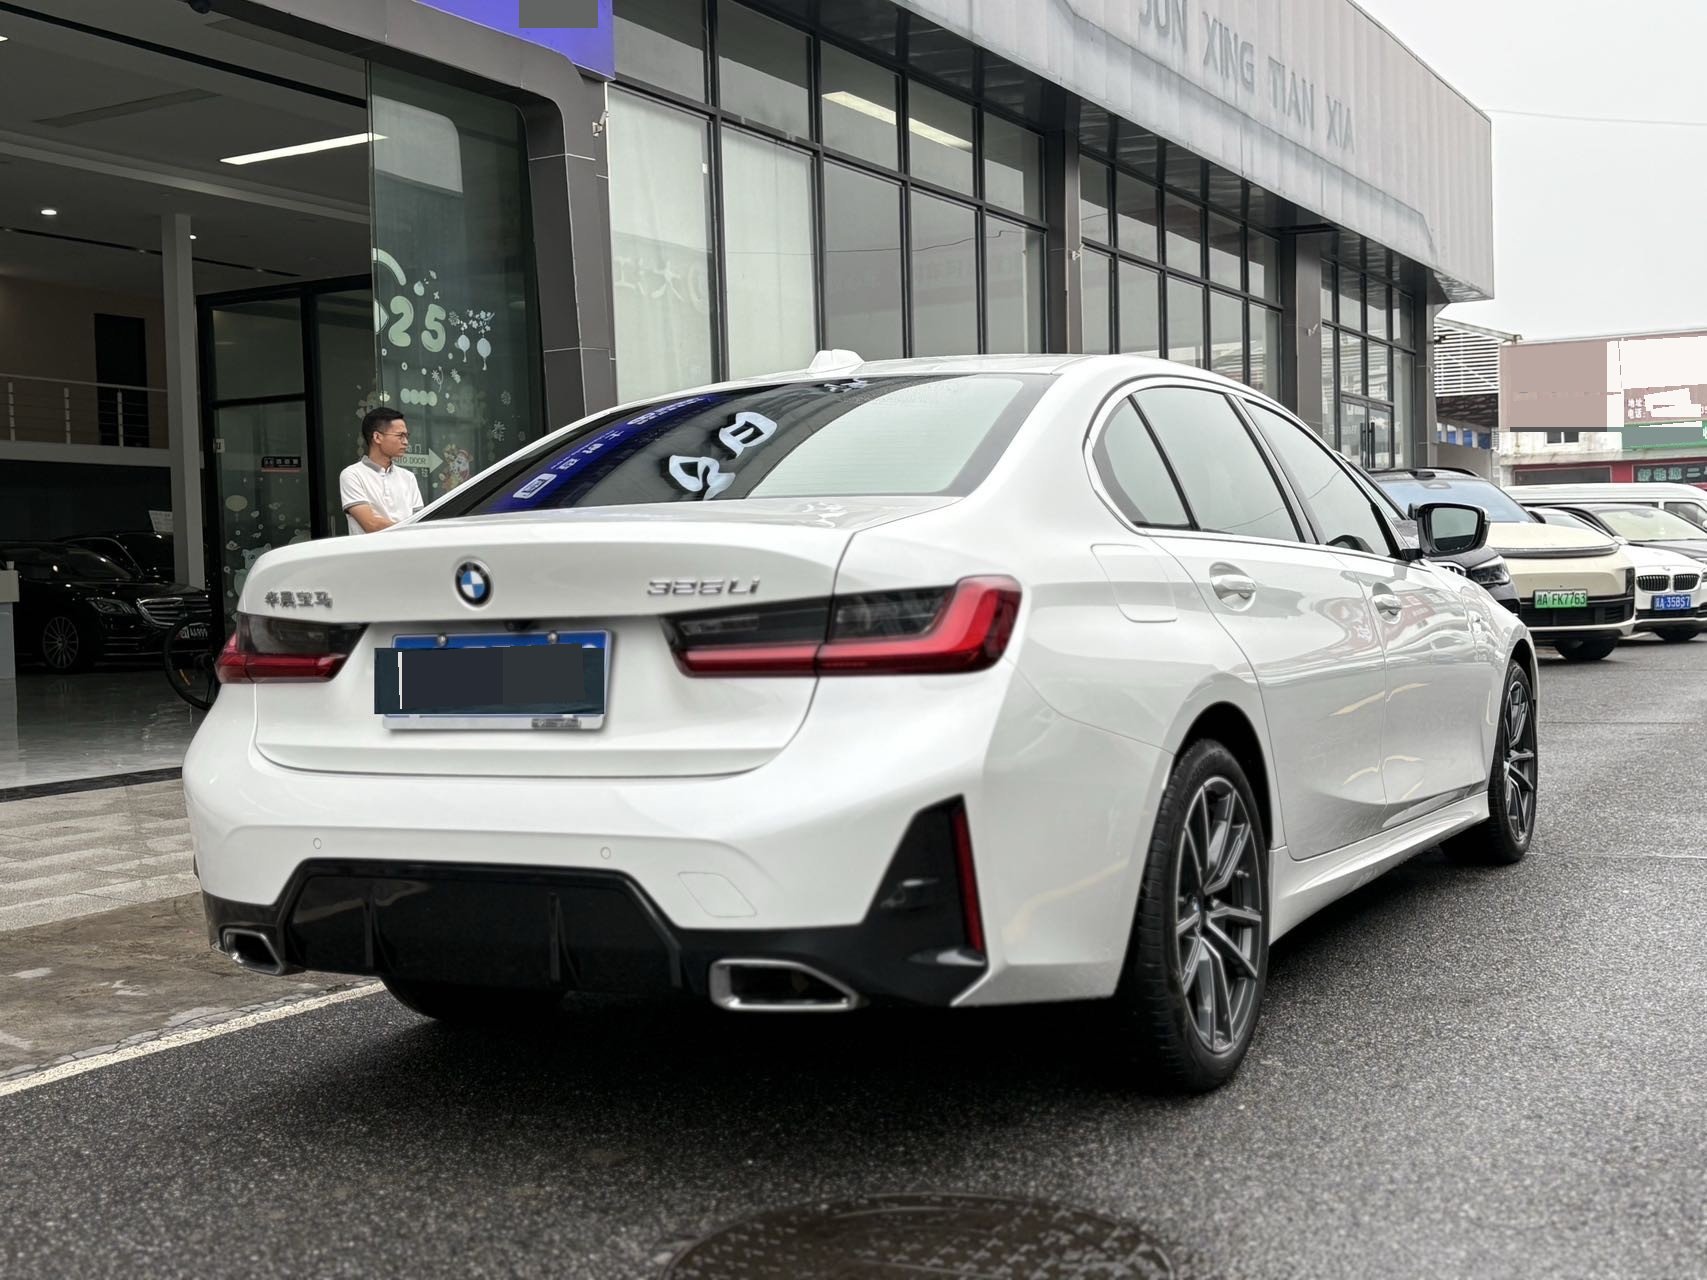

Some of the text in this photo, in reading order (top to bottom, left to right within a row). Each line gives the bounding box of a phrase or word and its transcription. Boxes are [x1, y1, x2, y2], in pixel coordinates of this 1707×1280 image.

[1202, 11, 1256, 94] XING
[1268, 56, 1315, 131] TIAN
[1326, 95, 1356, 154] XIA
[647, 577, 760, 595] 325Li
[264, 590, 333, 608] 华晨宝马
[1552, 592, 1587, 606] FK7763
